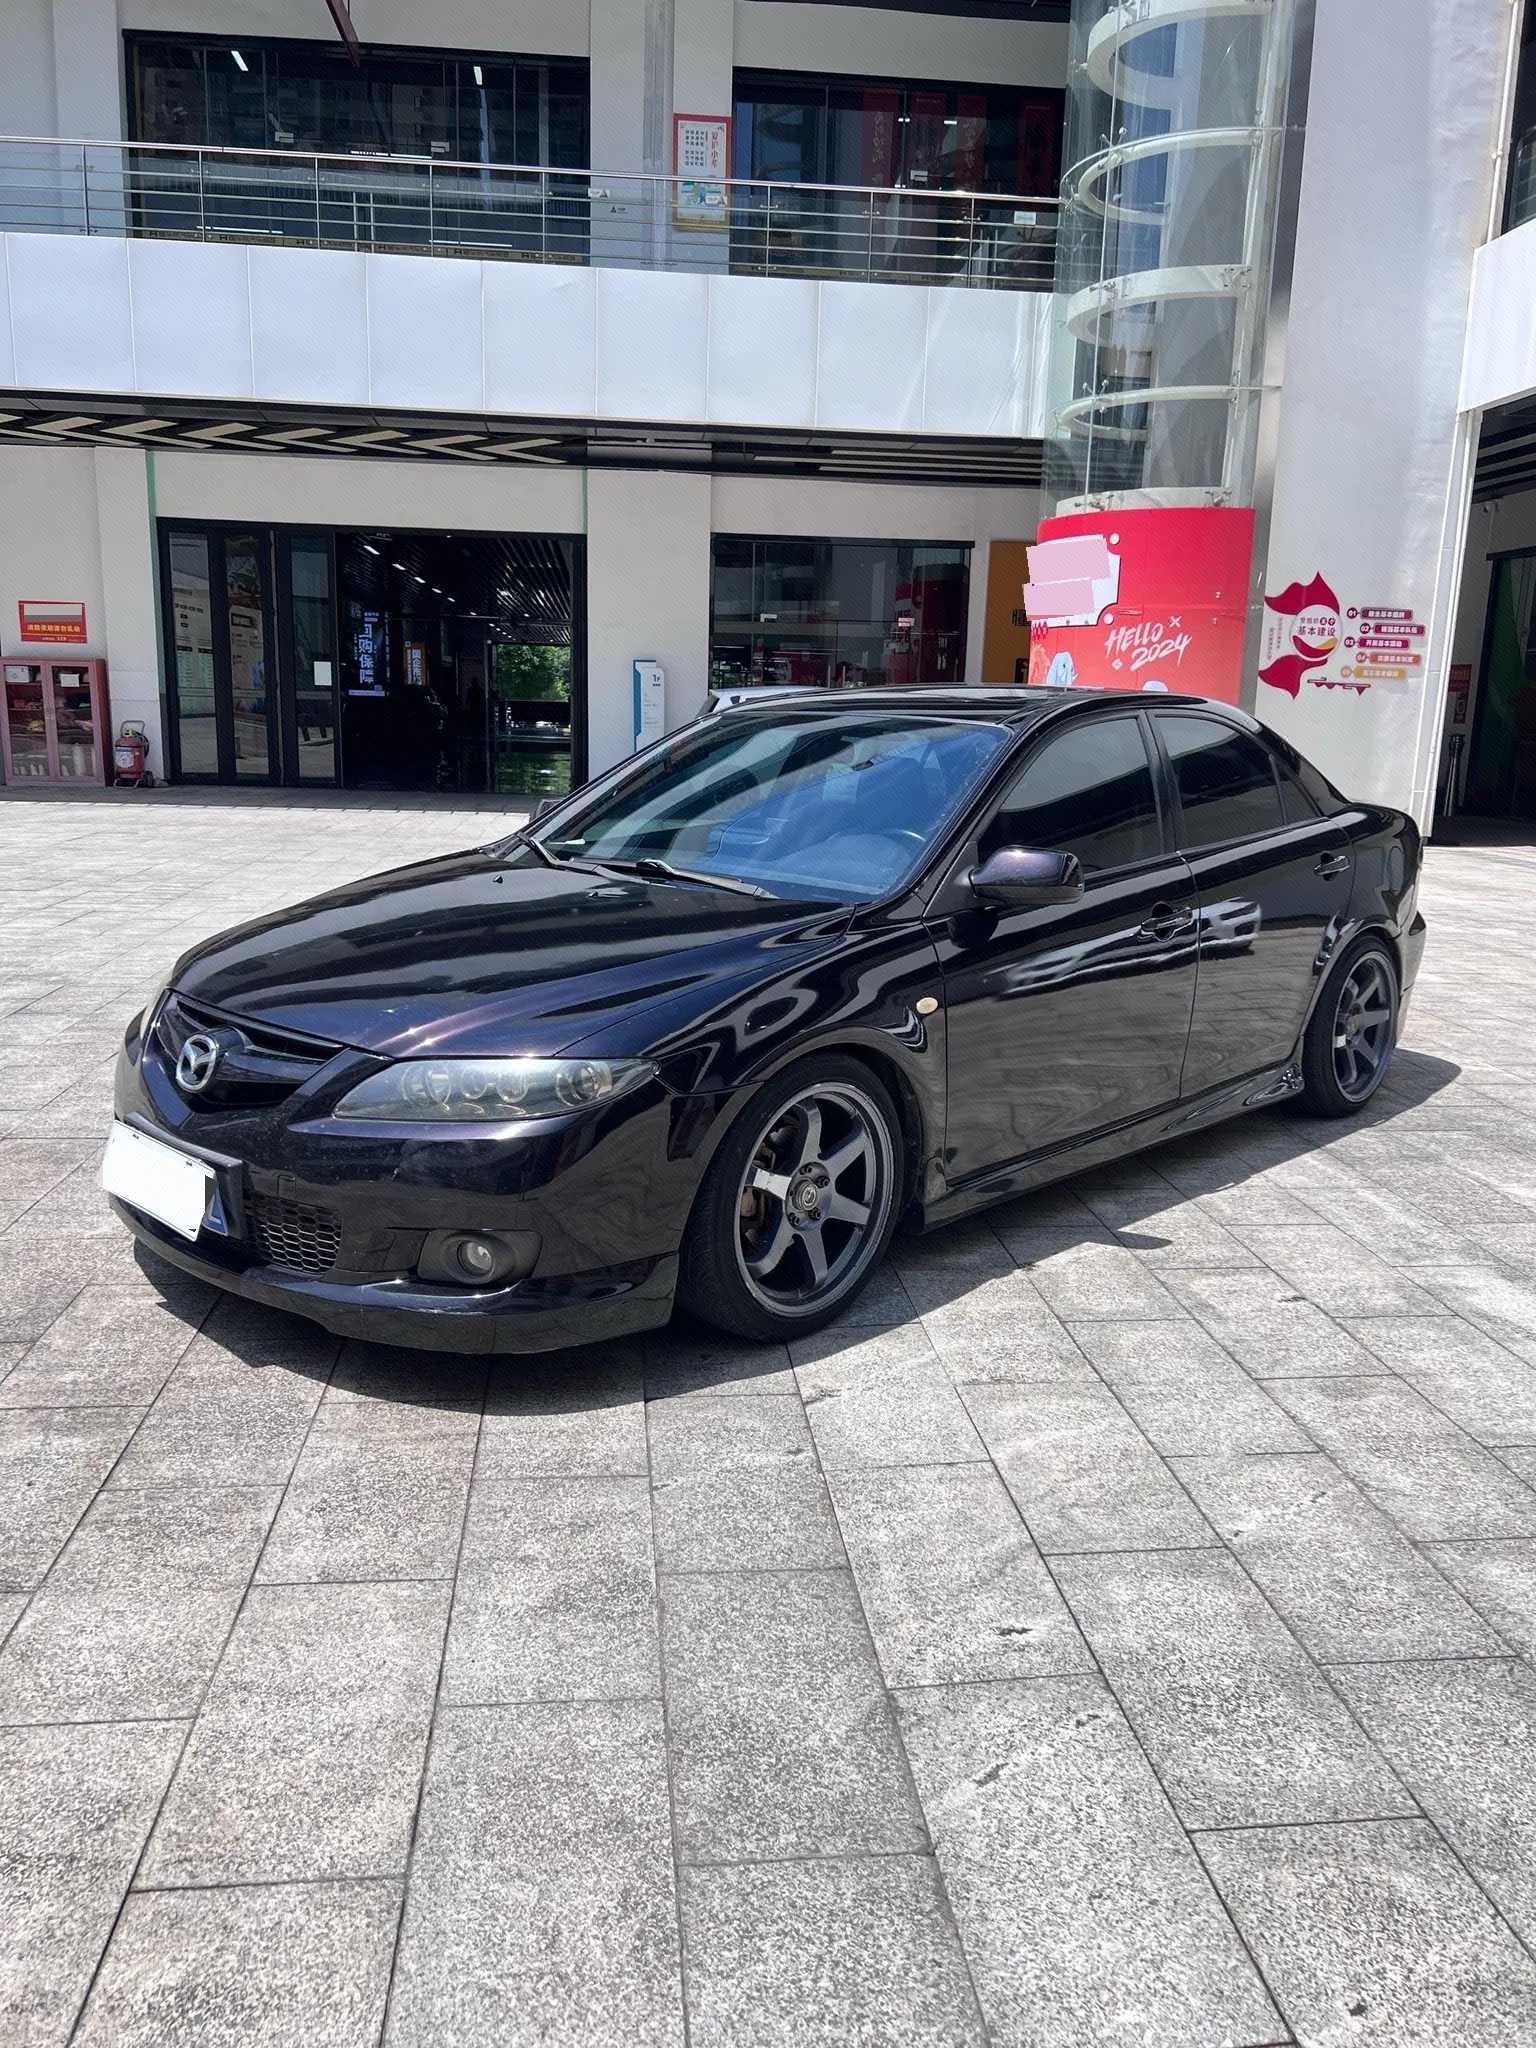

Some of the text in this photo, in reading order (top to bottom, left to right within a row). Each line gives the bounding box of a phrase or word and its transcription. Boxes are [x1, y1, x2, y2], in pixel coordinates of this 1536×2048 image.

[1104, 622, 1163, 660] HELLO
[1298, 626, 1336, 637] 基本建设
[1130, 633, 1193, 672] 2024
[1366, 640, 1403, 648] 开展基本活动
